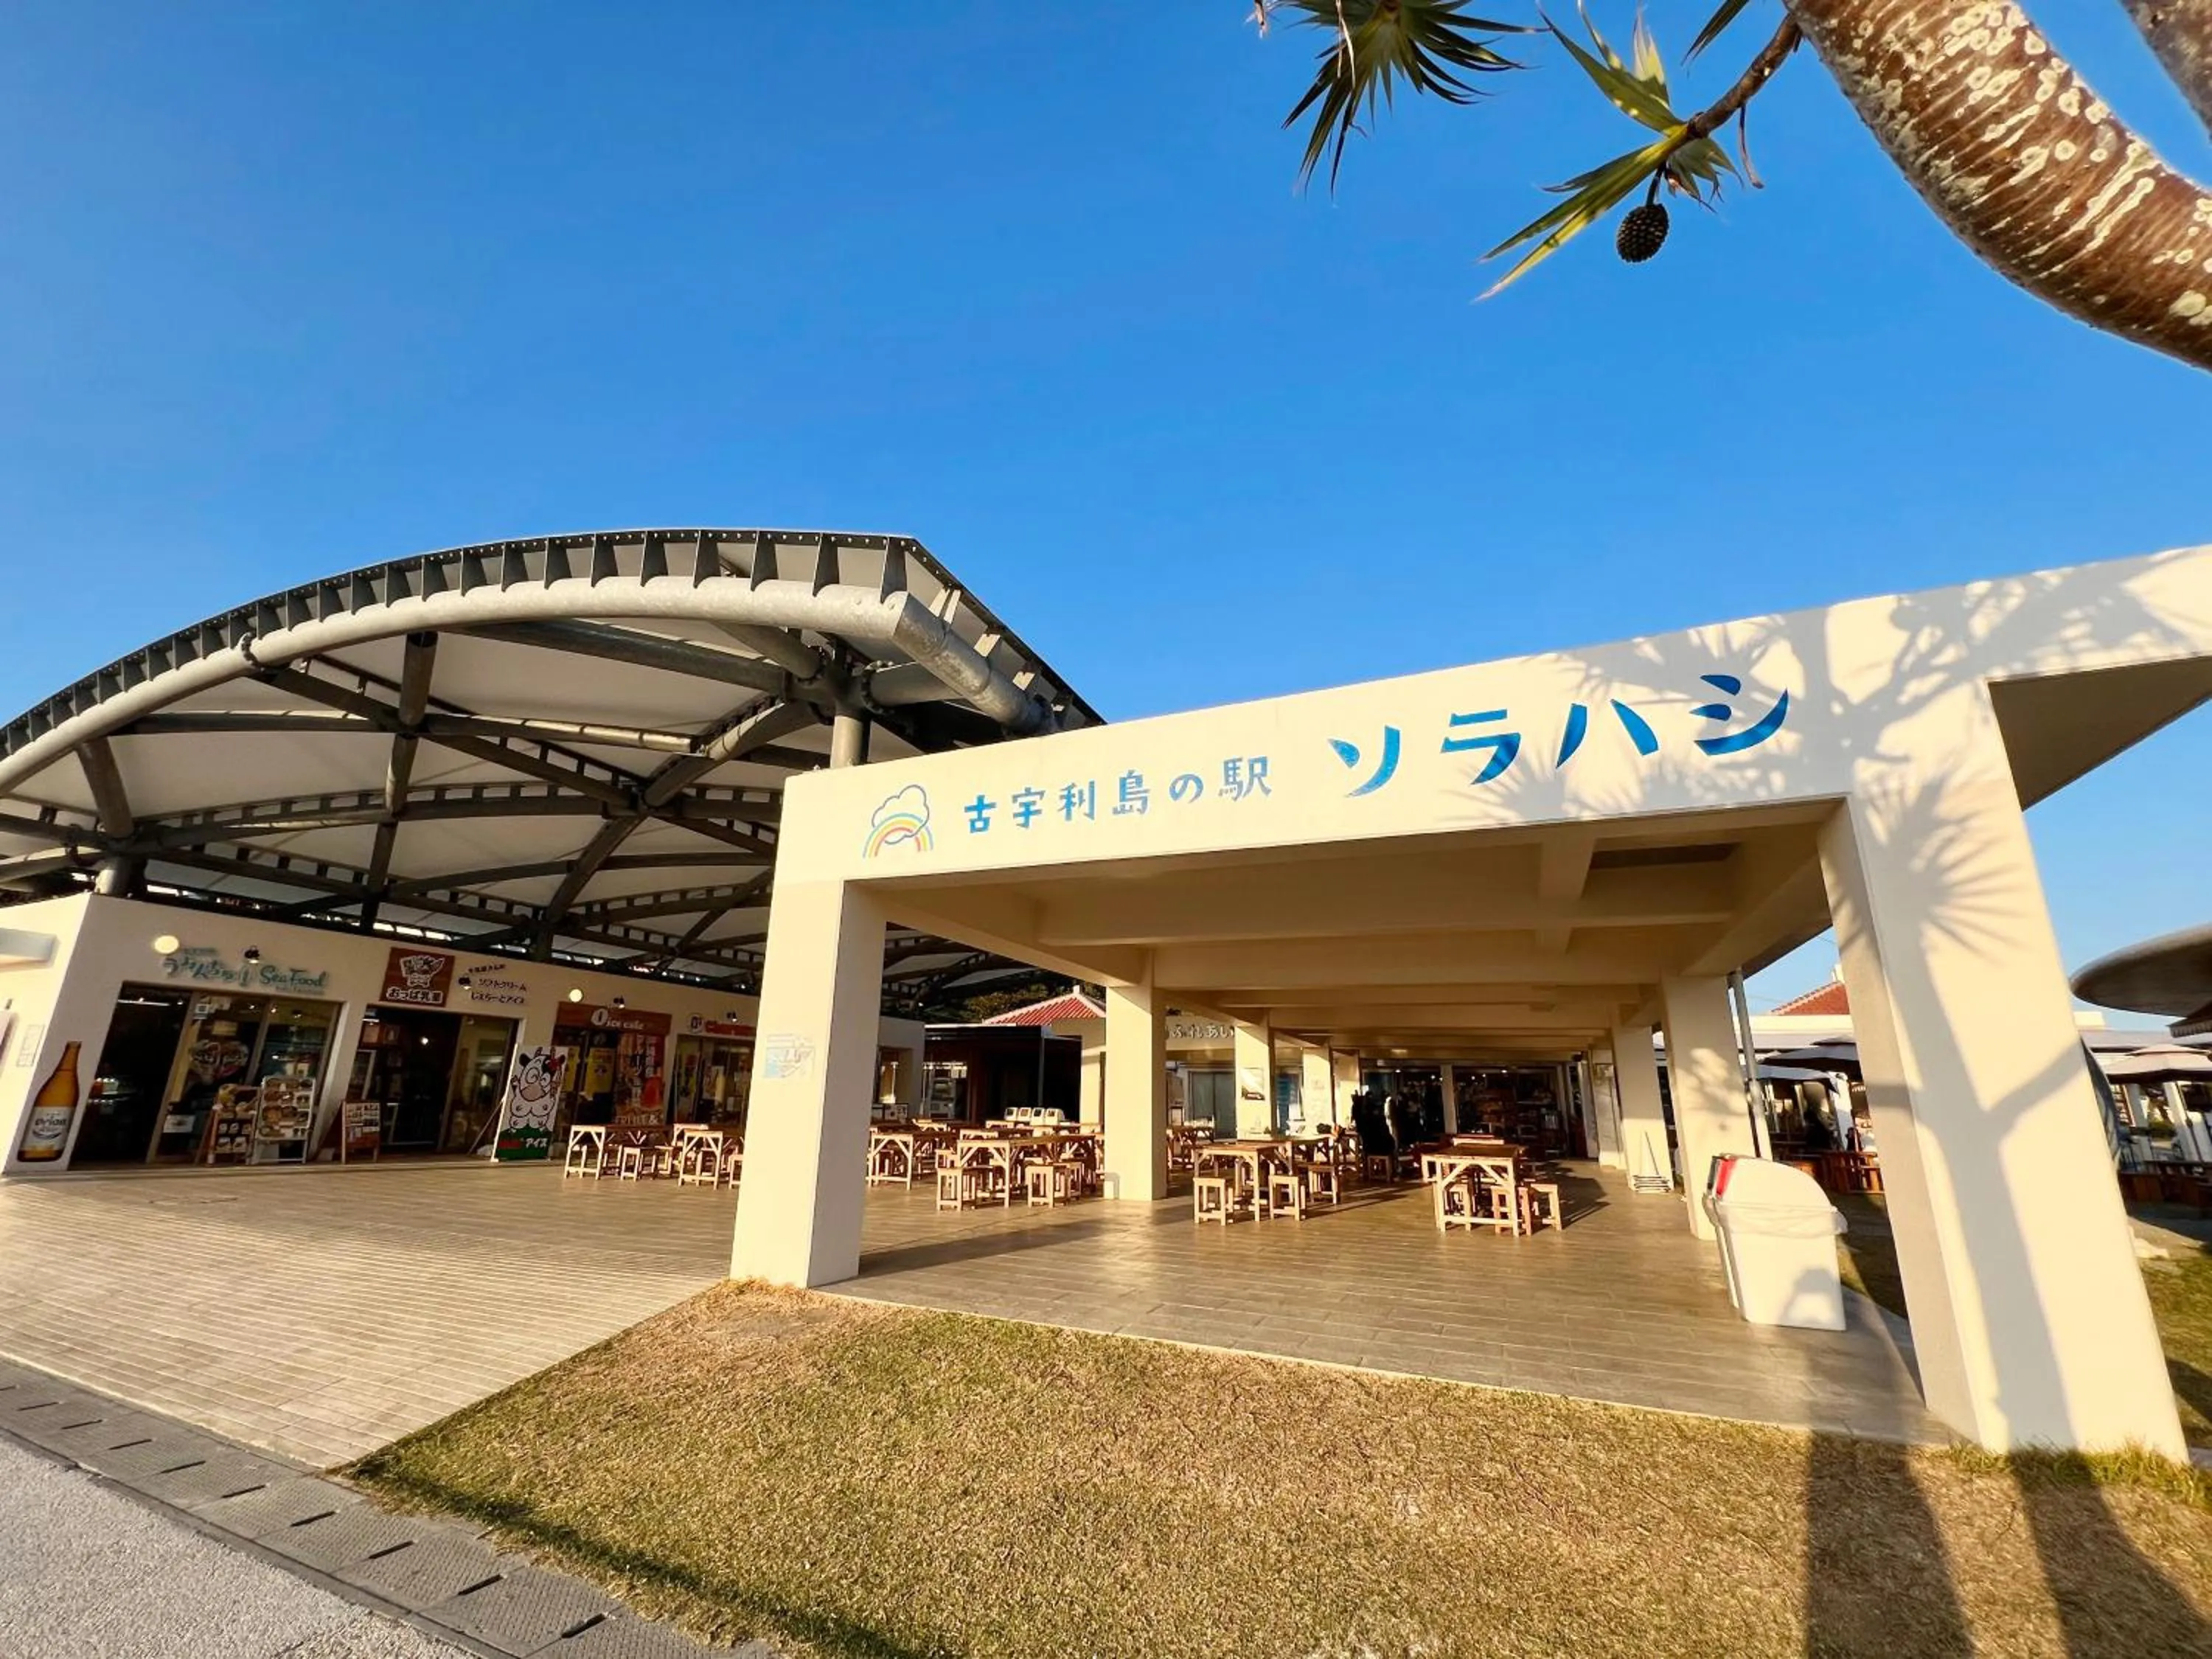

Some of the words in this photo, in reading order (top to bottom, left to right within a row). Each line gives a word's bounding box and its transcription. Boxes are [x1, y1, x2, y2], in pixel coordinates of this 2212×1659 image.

[964, 756, 1273, 835] 古宇利島の駅
[1328, 675, 1789, 798] ソラハシ
